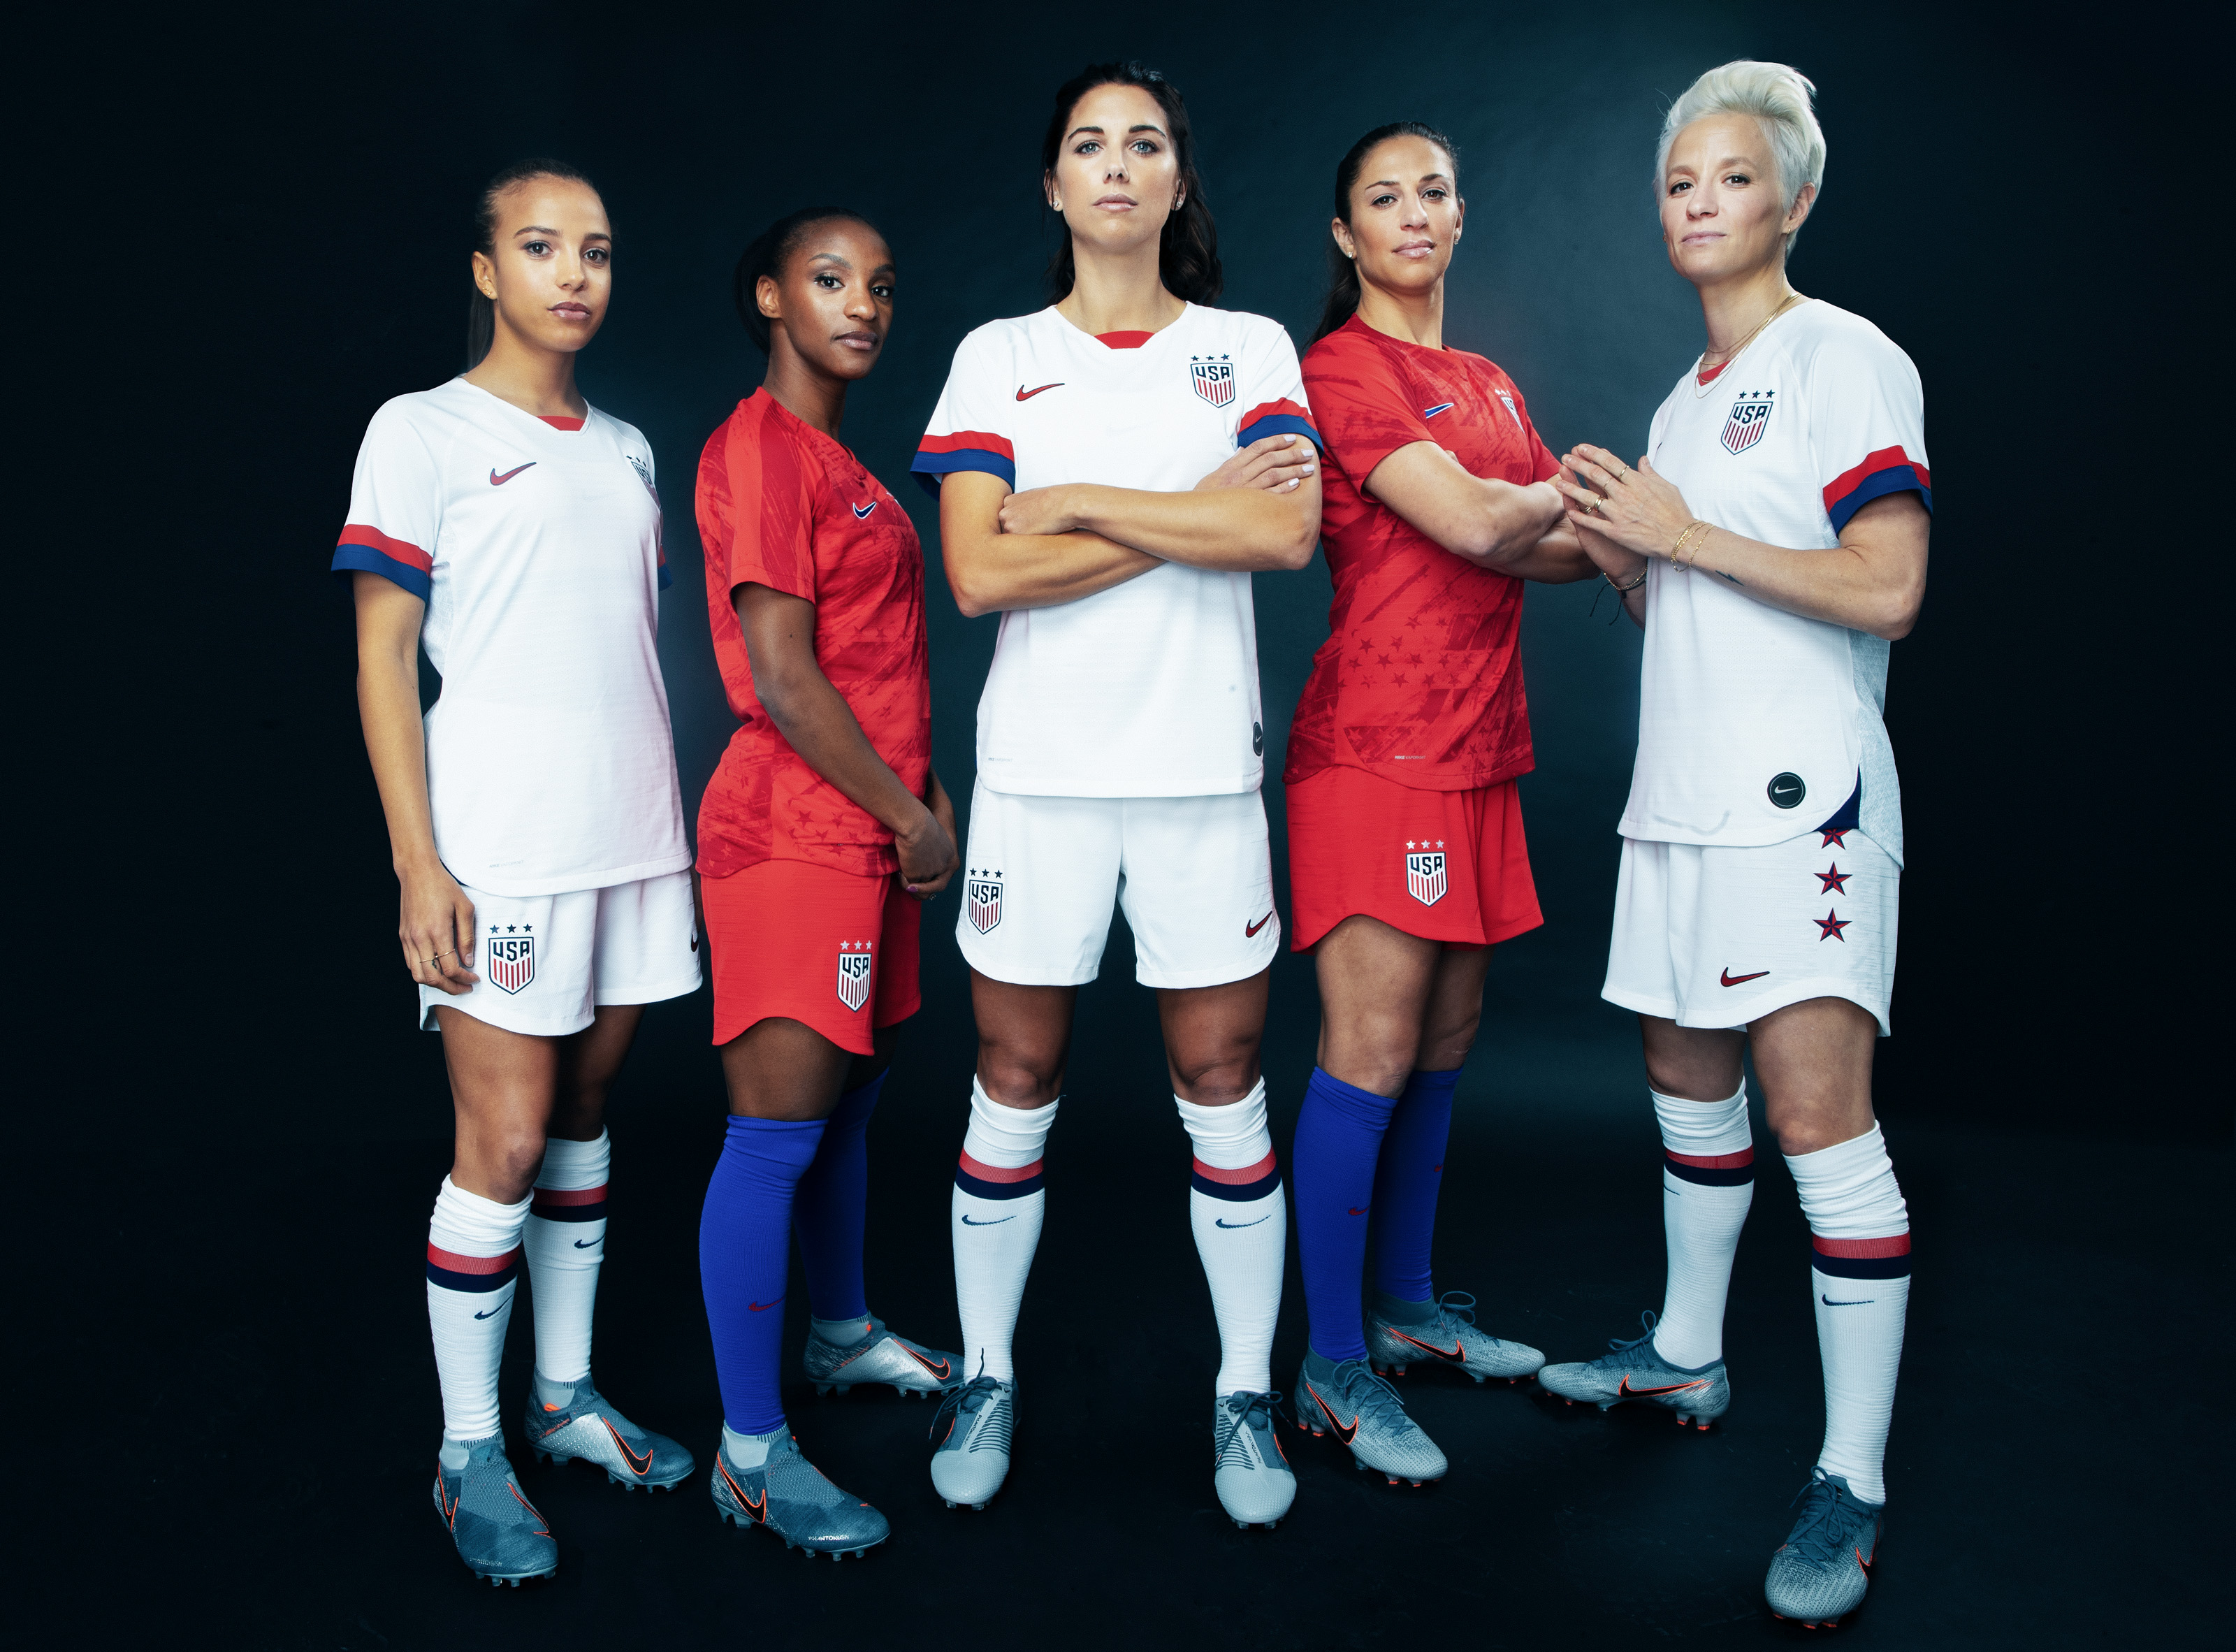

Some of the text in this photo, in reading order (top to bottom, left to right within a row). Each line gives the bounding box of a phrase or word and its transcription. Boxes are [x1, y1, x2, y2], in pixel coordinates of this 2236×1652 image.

[1195, 366, 1230, 382] USA
[1733, 405, 1768, 424] USA
[1410, 856, 1442, 876] USA
[971, 883, 999, 904] USA
[493, 941, 530, 962] USA
[842, 957, 869, 978] USA
